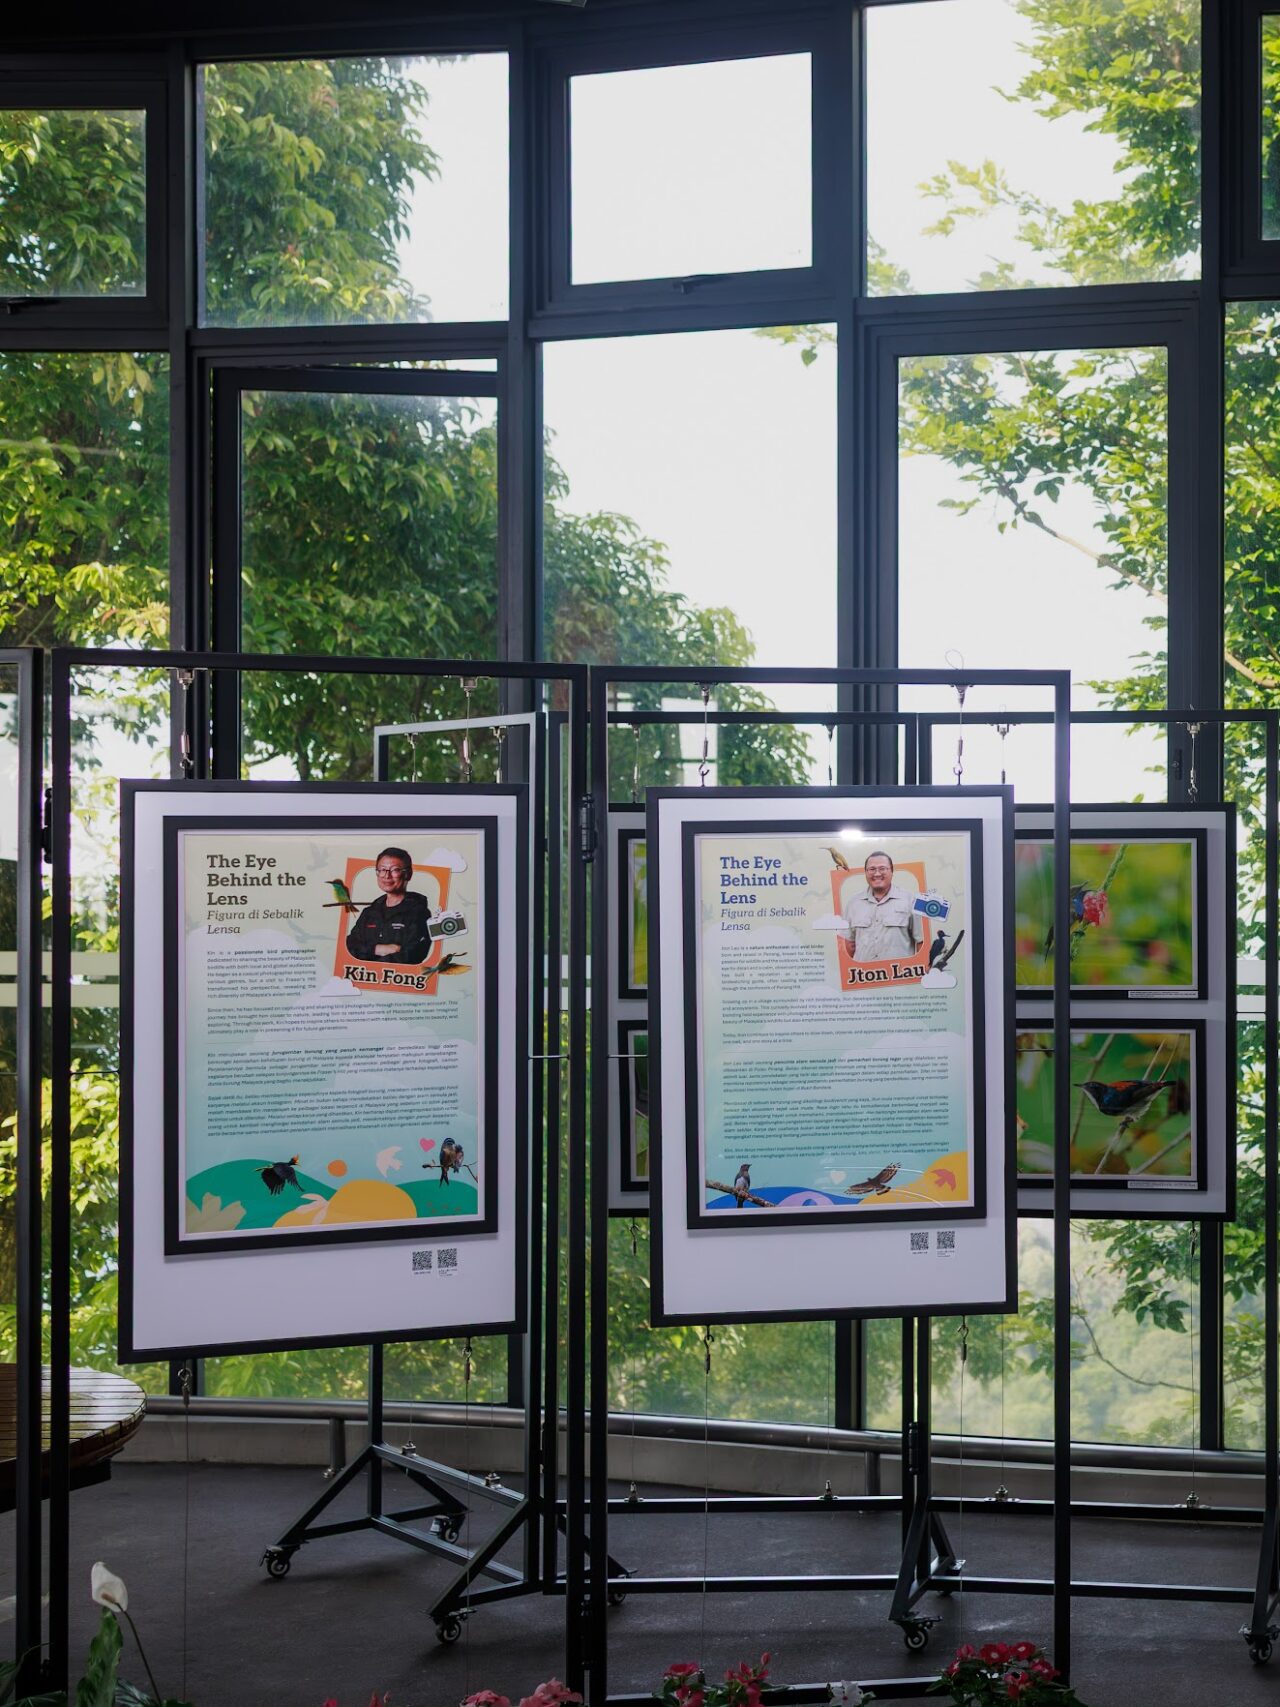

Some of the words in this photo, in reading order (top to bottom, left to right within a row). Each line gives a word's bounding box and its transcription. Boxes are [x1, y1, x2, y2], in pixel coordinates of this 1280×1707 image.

[207, 855, 240, 867] The
[245, 855, 276, 870] Eye
[720, 857, 749, 869] The
[754, 857, 781, 871] Eye
[207, 873, 272, 886] Behind
[277, 873, 306, 886] the
[721, 873, 777, 886] Behind
[782, 873, 808, 885] the
[207, 892, 248, 905] Lens
[721, 892, 756, 904] Lens
[207, 911, 244, 921] Figura
[249, 909, 259, 919] di
[262, 909, 304, 919] Sebalik
[721, 909, 754, 919] Figura
[757, 908, 767, 917] di
[770, 907, 806, 917] Sebalik
[208, 925, 240, 934] Lensa
[721, 922, 750, 930] Lensa
[344, 966, 377, 982] Kin
[382, 969, 426, 989] Fong
[849, 969, 888, 983] Jton
[892, 965, 925, 979] Lau
